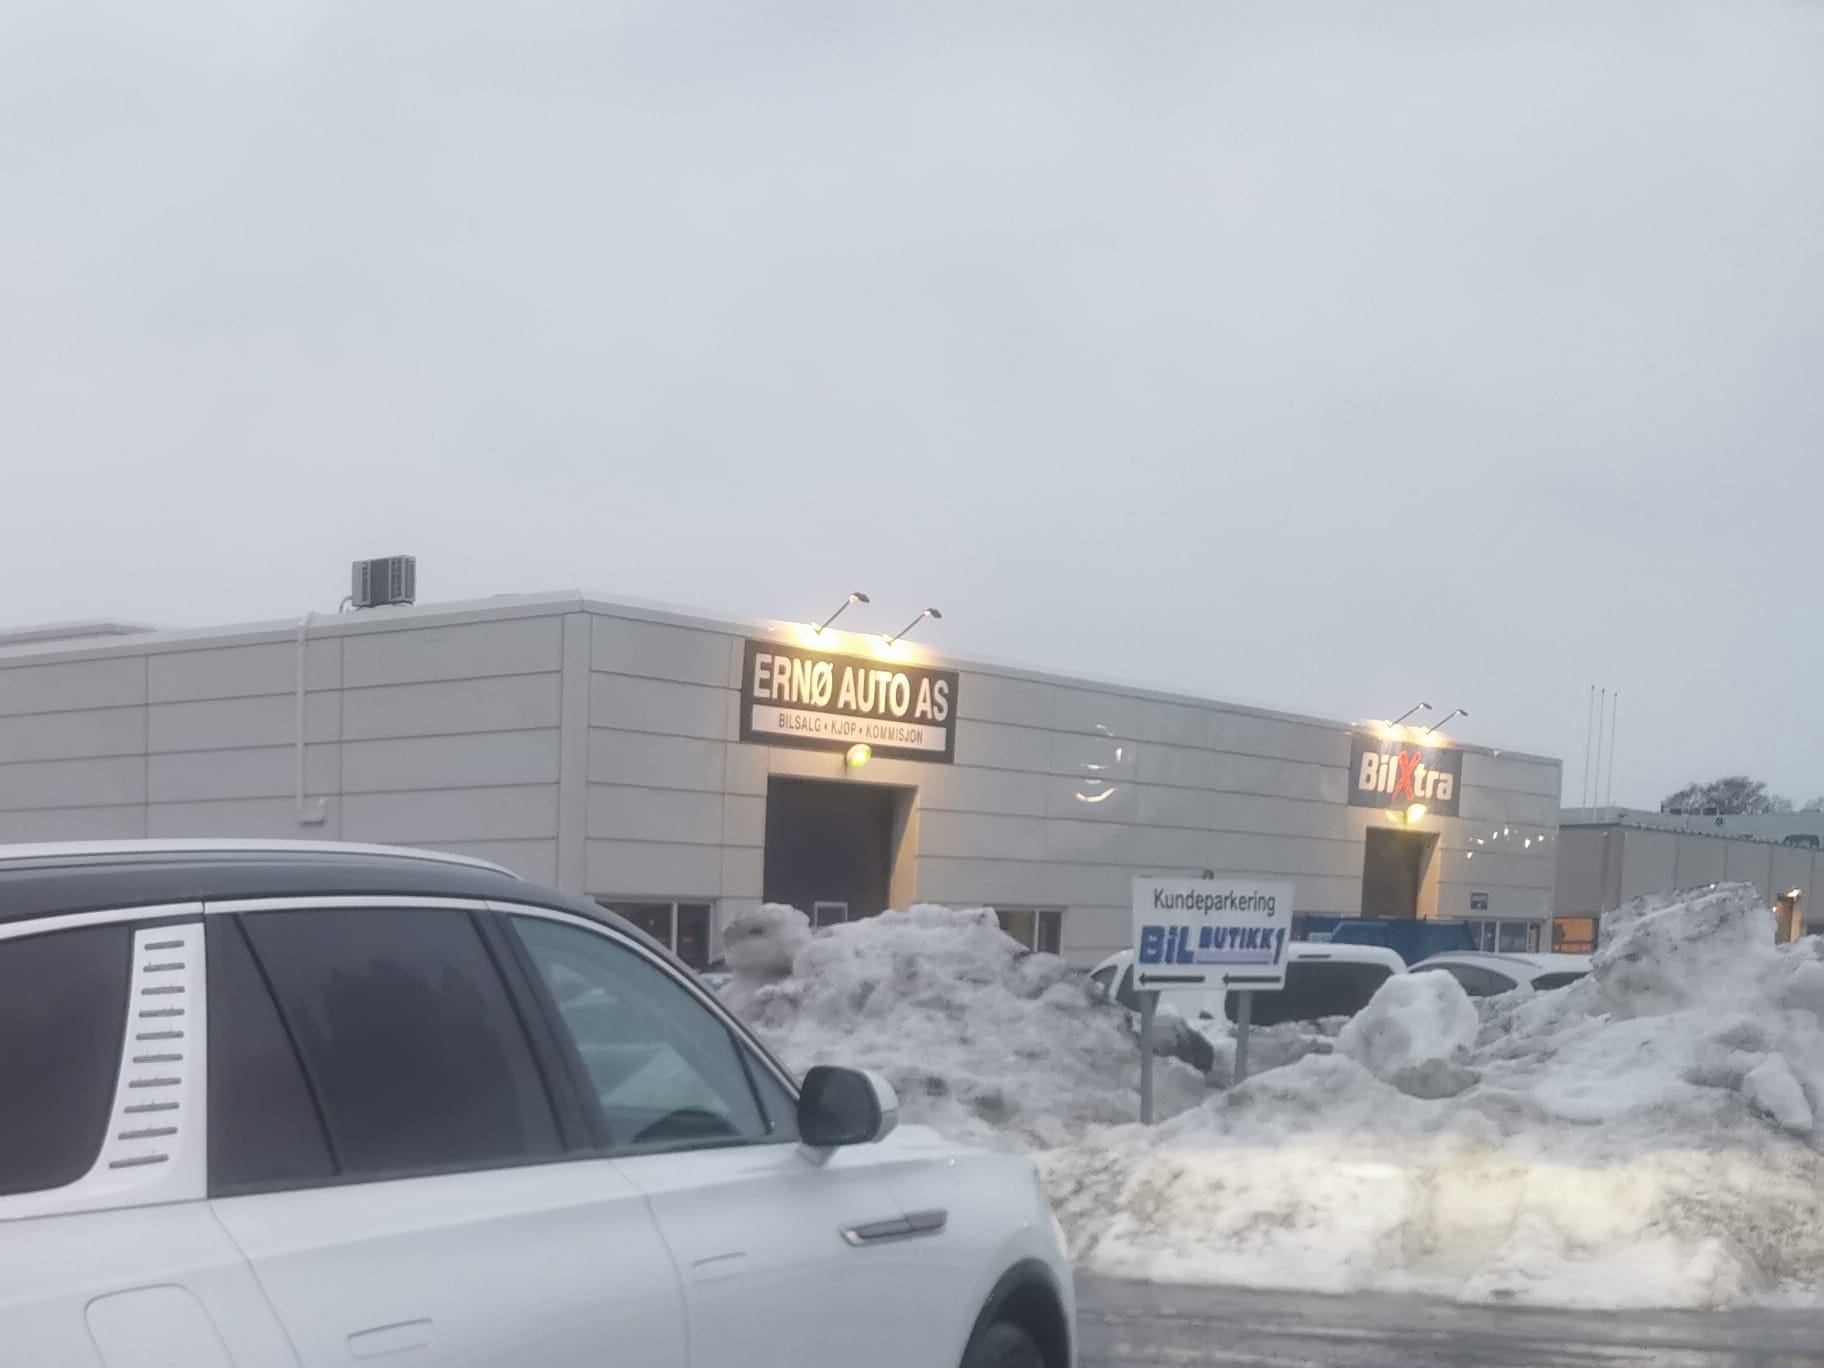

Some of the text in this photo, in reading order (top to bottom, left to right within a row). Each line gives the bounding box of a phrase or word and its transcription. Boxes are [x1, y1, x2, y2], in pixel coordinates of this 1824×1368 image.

[753, 652, 949, 722] ERNØ AUTO AS
[778, 713, 924, 745] BILSALG KJØP KOMMISJON
[1358, 750, 1454, 801] BilXtra
[1153, 888, 1276, 917] Kundeparkering
